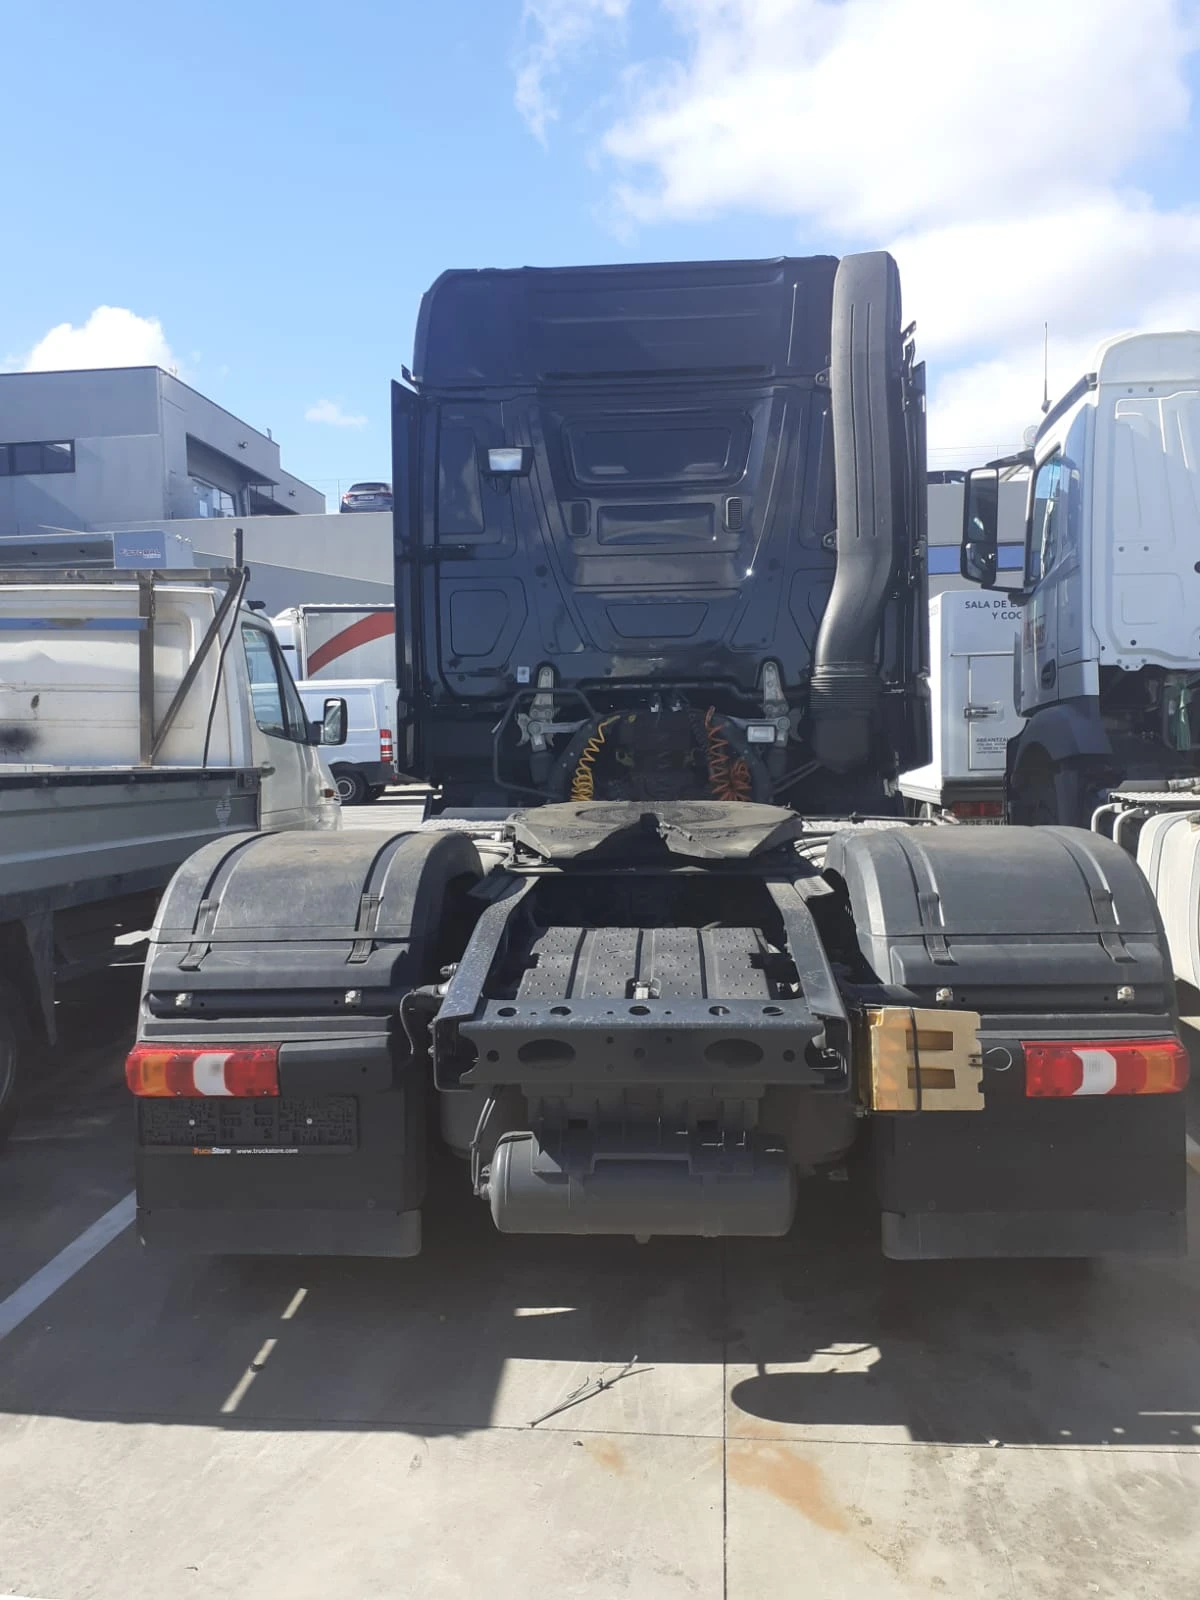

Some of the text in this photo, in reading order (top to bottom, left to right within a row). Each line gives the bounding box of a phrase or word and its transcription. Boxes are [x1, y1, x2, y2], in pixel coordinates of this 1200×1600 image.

[965, 601, 991, 609] SALA
[994, 600, 1008, 608] DE
[992, 611, 1022, 620] Y COC
